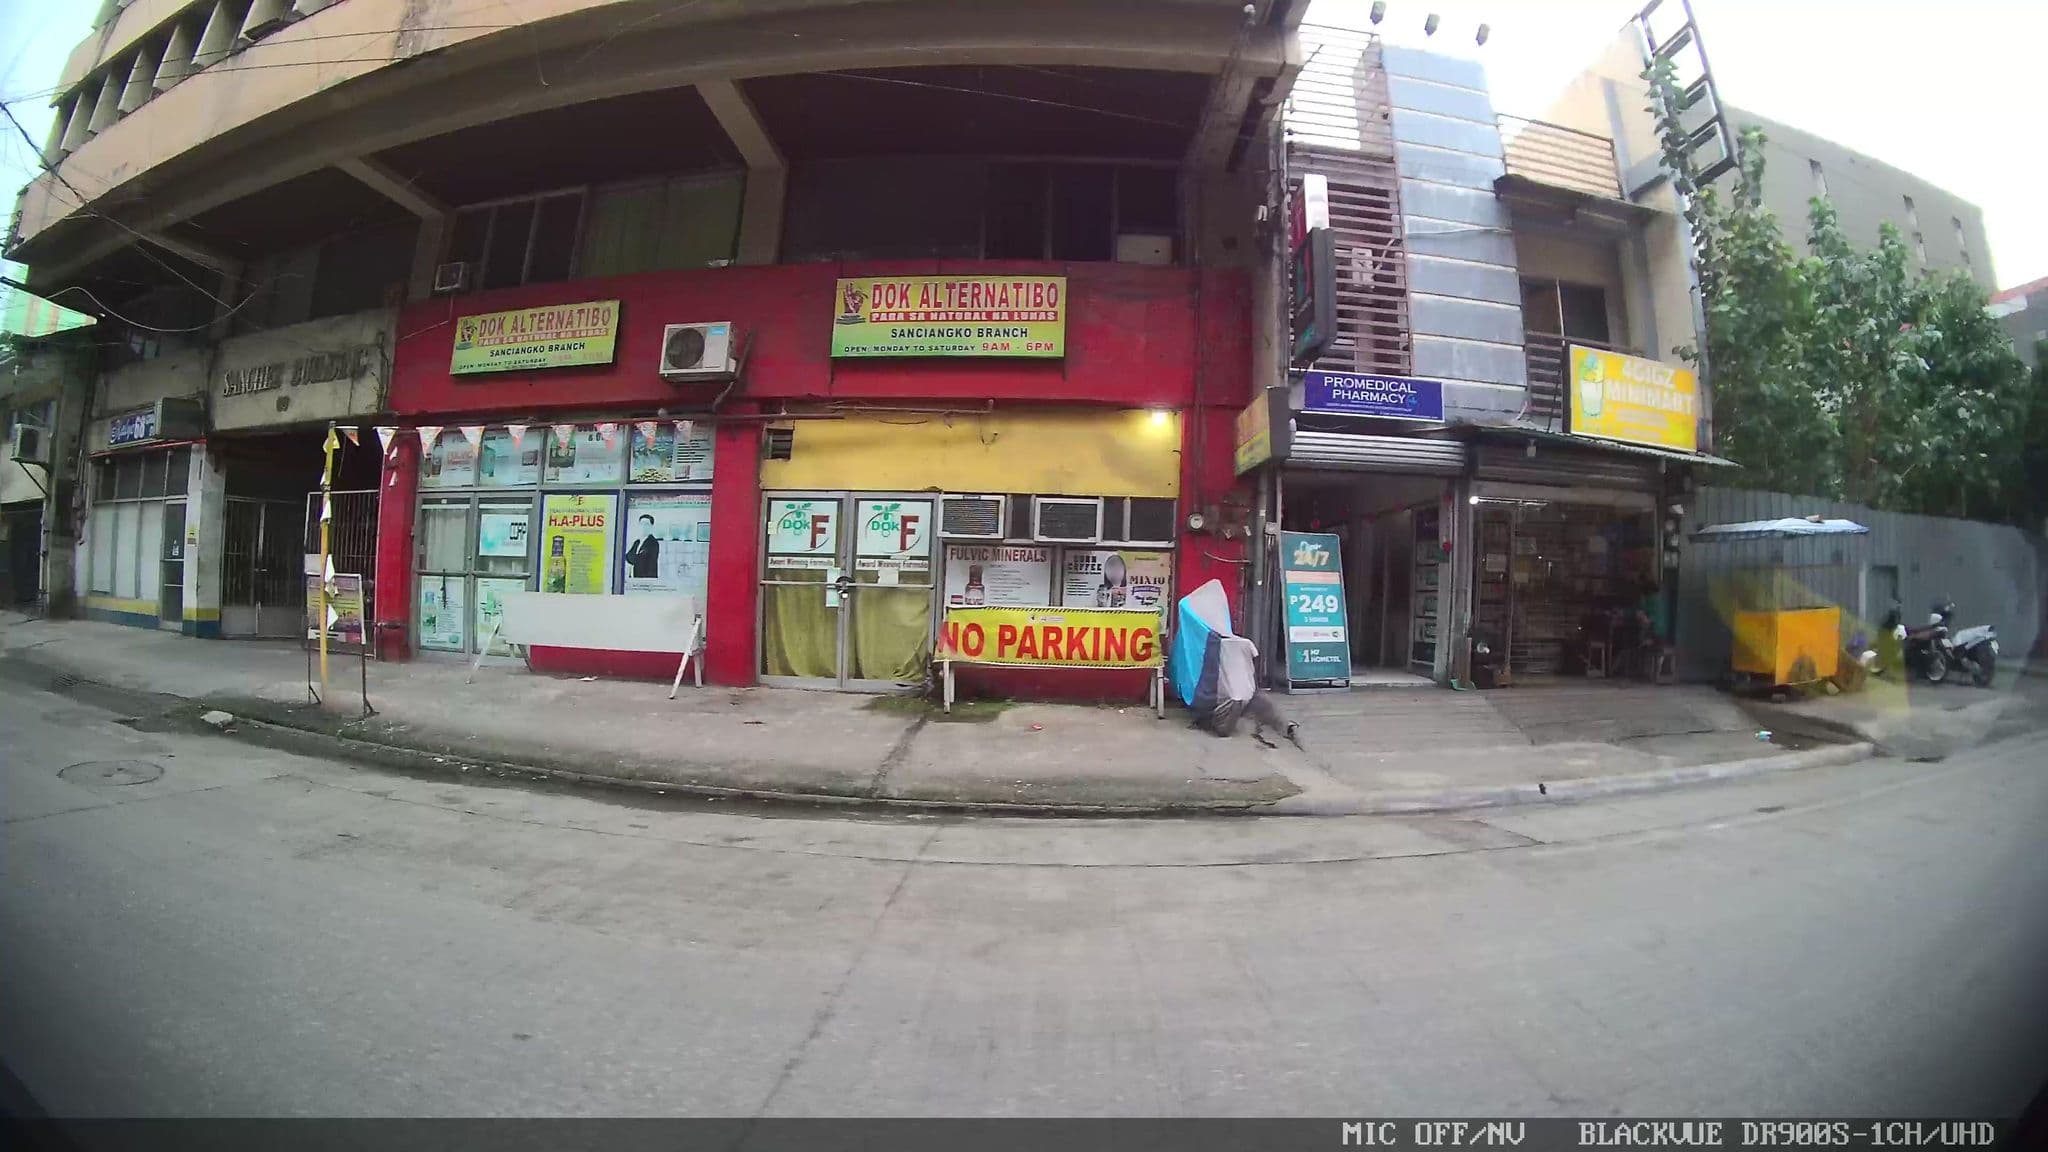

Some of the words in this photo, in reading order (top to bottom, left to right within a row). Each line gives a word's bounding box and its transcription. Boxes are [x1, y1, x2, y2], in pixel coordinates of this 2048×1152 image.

[872, 283, 911, 309] DOK
[919, 282, 1058, 308] ALTERNATIBO
[479, 315, 505, 337] DOK
[511, 306, 611, 334] ALTERNATIBO
[890, 328, 972, 338] SANCIANGKO
[977, 328, 1028, 338] BRANCH
[490, 346, 545, 357] SANCIANGKO
[548, 342, 585, 352] BRANCH
[982, 342, 1010, 352] 9AM
[1026, 342, 1054, 352] 6PM
[1324, 376, 1417, 394] PROMEDICAL
[1332, 389, 1407, 404] PHARMACY
[810, 515, 830, 548] F
[900, 515, 919, 550] F
[950, 547, 989, 560] FULVIC
[993, 548, 1047, 562] MINERALS
[938, 621, 985, 656] NO
[997, 624, 1153, 662] PARKING
